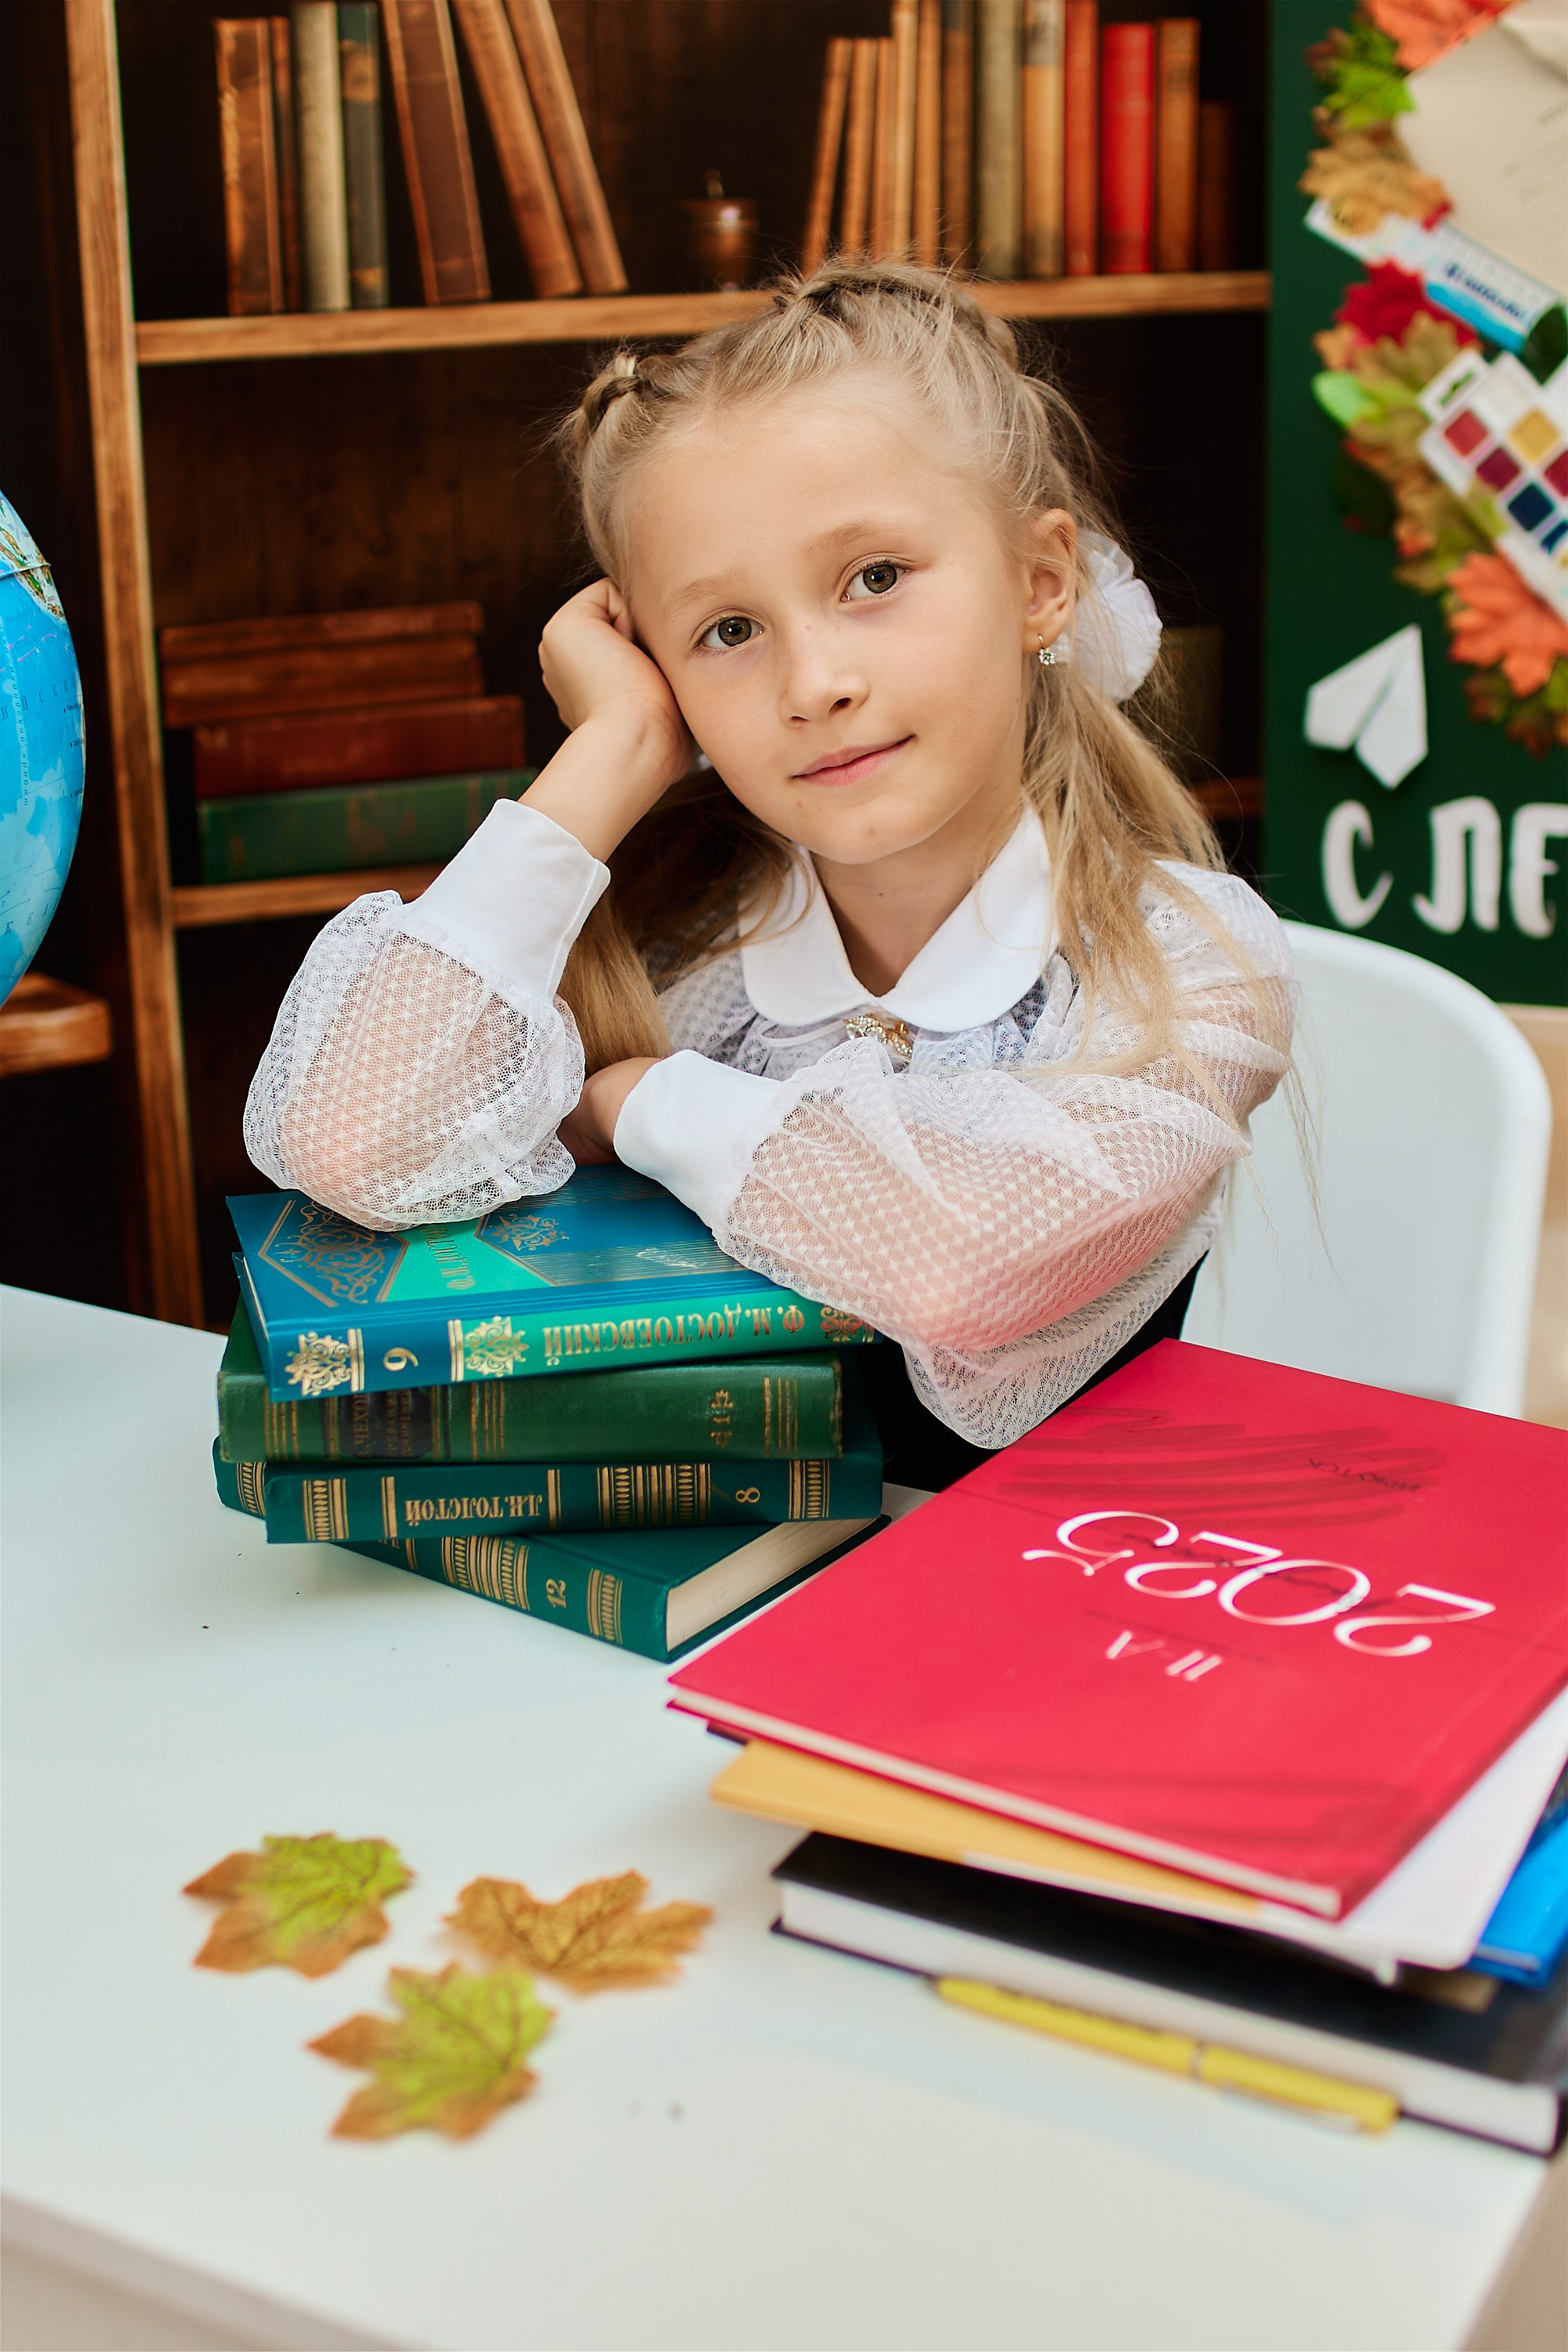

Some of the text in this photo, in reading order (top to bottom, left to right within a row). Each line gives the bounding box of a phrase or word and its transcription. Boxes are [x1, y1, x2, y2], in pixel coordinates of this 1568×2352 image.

[1322, 799, 1393, 930] С
[735, 1487, 761, 1503] 8
[546, 1578, 567, 1609] 12
[1023, 1511, 1496, 1657] 2025
